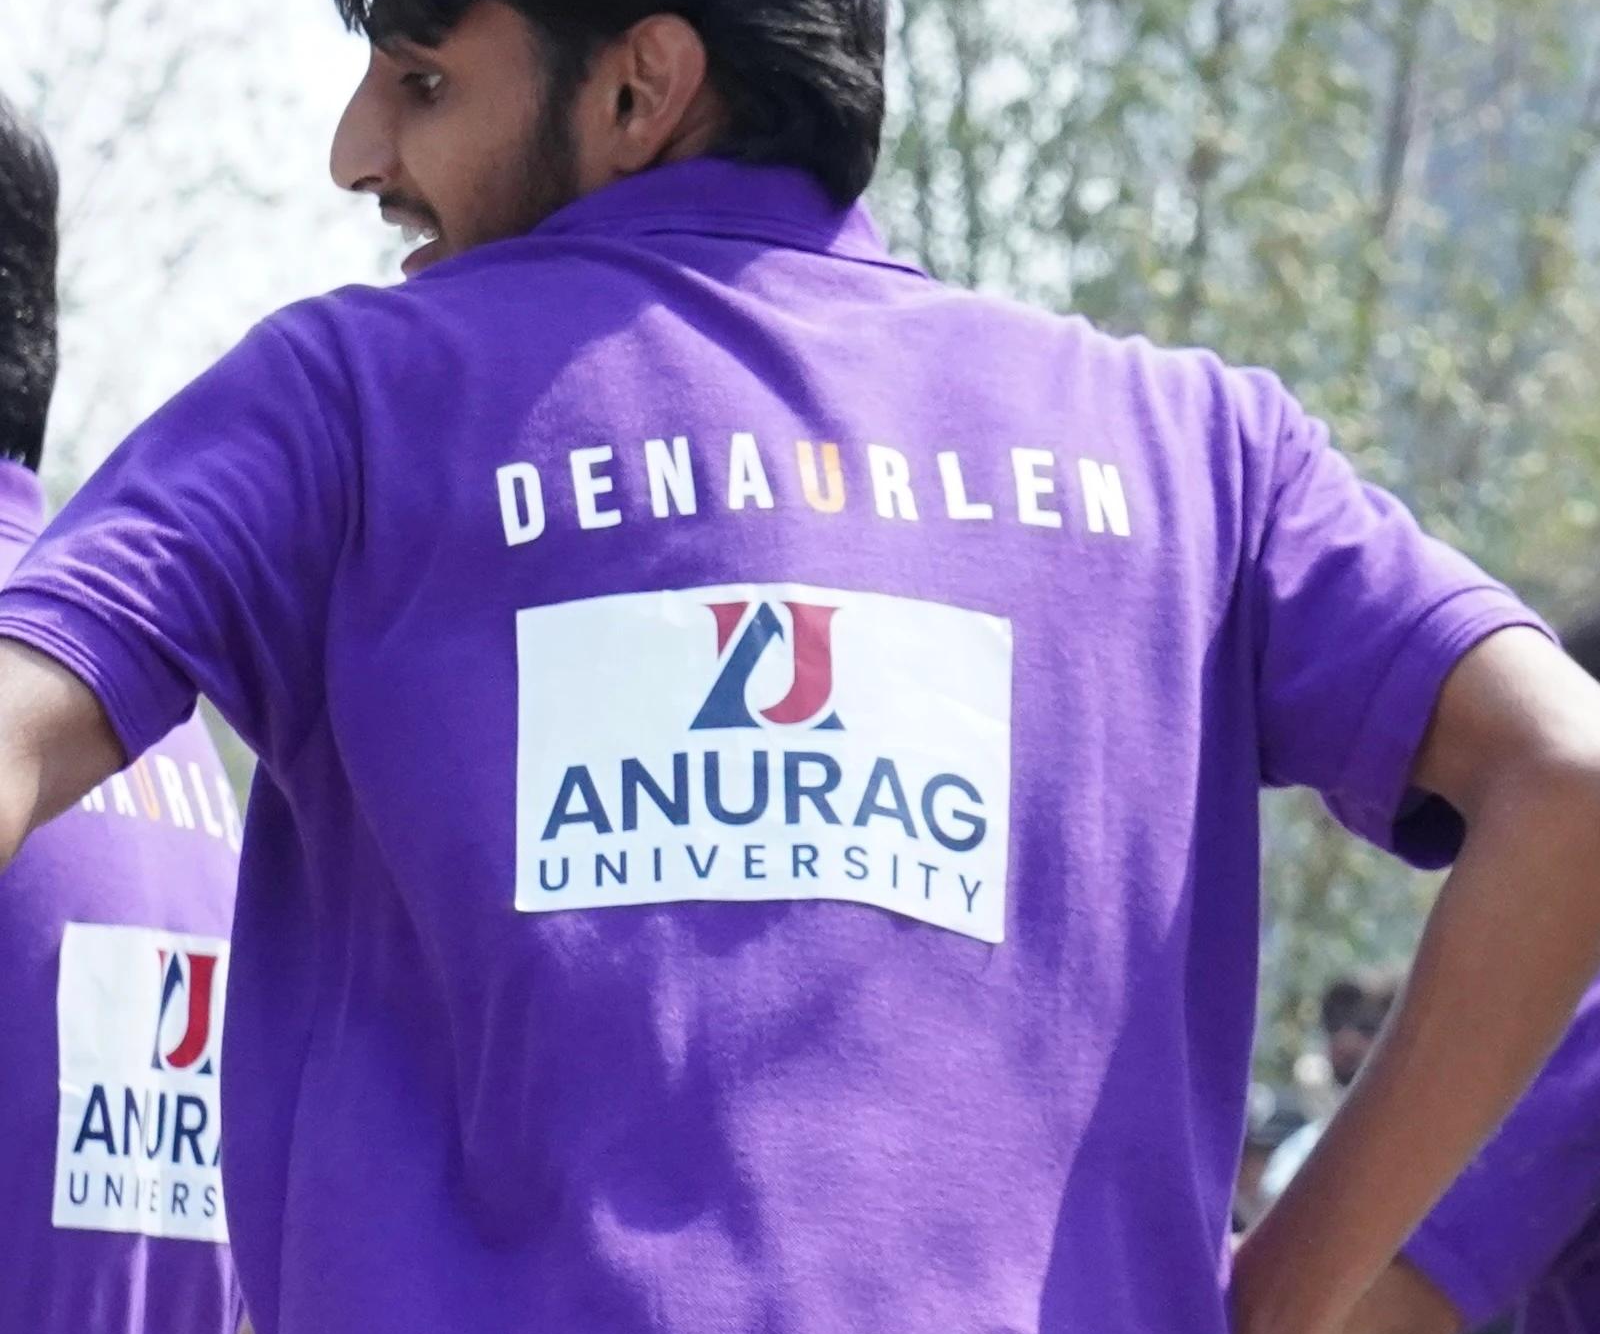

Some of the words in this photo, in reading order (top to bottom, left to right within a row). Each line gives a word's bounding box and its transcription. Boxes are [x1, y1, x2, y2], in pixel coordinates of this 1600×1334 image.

[496, 433, 1131, 546] DENAURLEN
[540, 750, 987, 852] ANURAG
[539, 844, 982, 913] UNIVERSITY
[72, 1083, 221, 1167] ANUR
